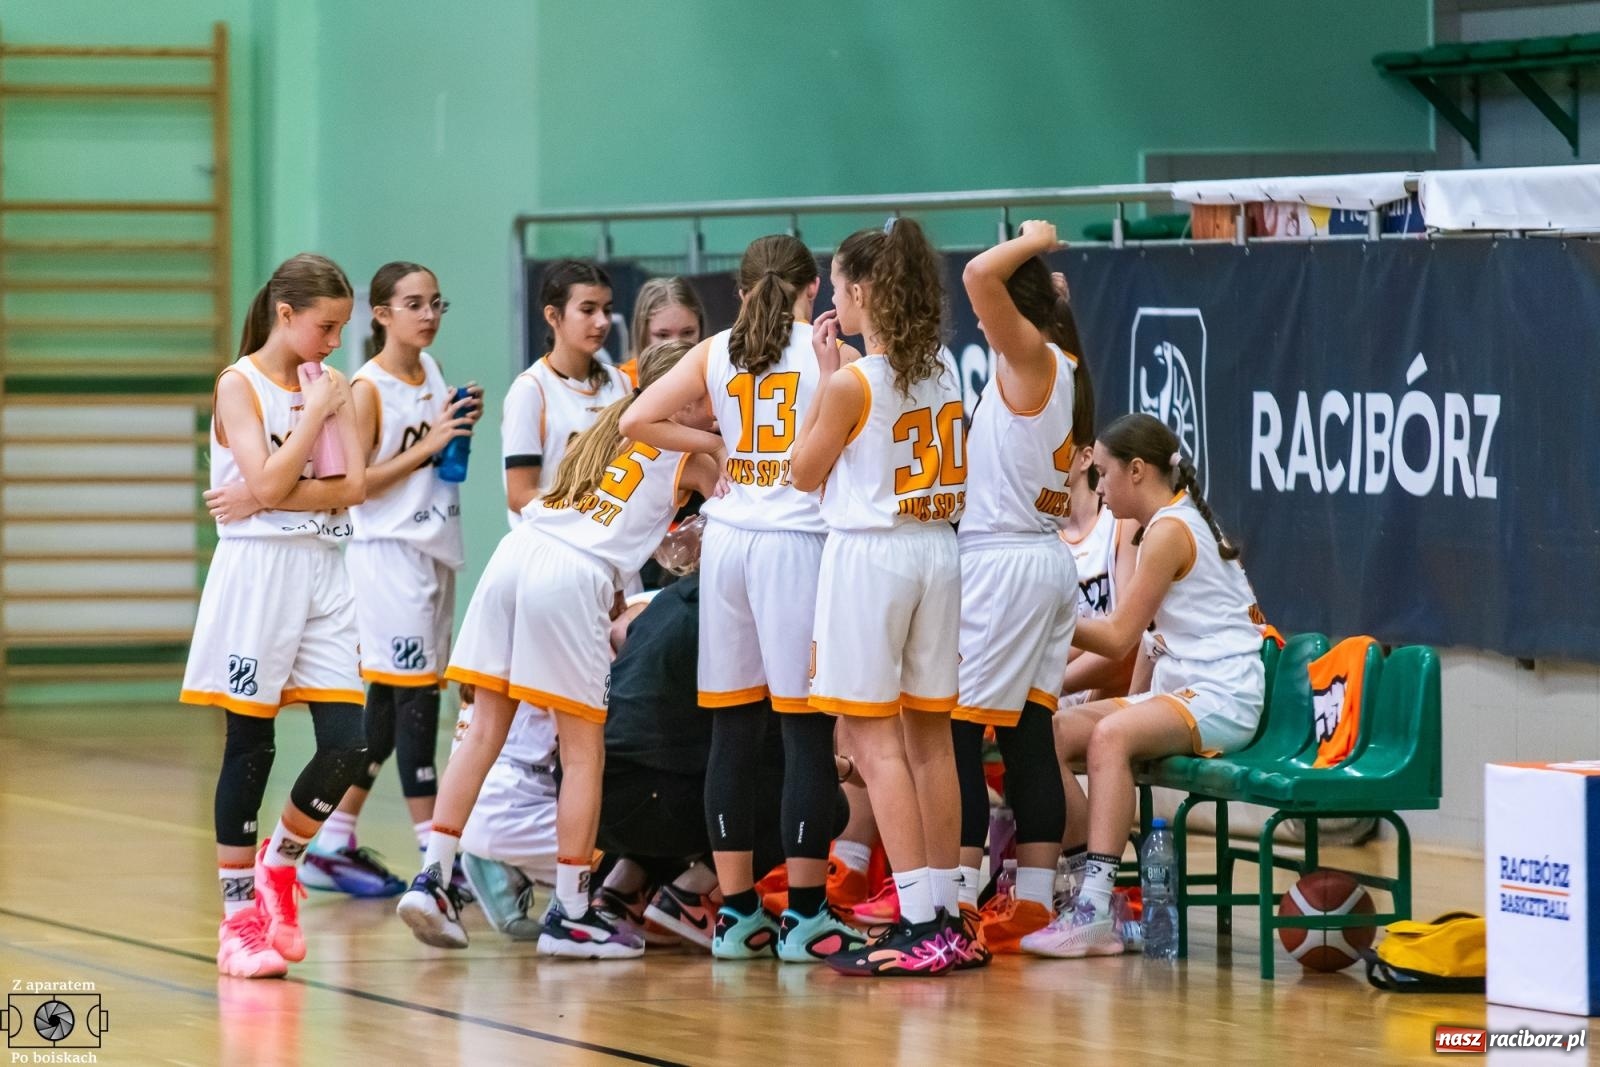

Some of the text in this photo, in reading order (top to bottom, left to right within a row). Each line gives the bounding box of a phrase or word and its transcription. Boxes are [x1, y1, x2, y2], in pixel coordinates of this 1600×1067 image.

[726, 371, 801, 453] 13
[1250, 351, 1501, 499] RACIBÓRZ
[892, 400, 967, 495] 30
[600, 441, 662, 503] 5
[757, 459, 781, 487] SP
[592, 500, 623, 527] 27
[932, 492, 956, 520] SP
[1500, 855, 1570, 888] RACIBÓRZ
[1500, 893, 1570, 921] BASKETBALL
